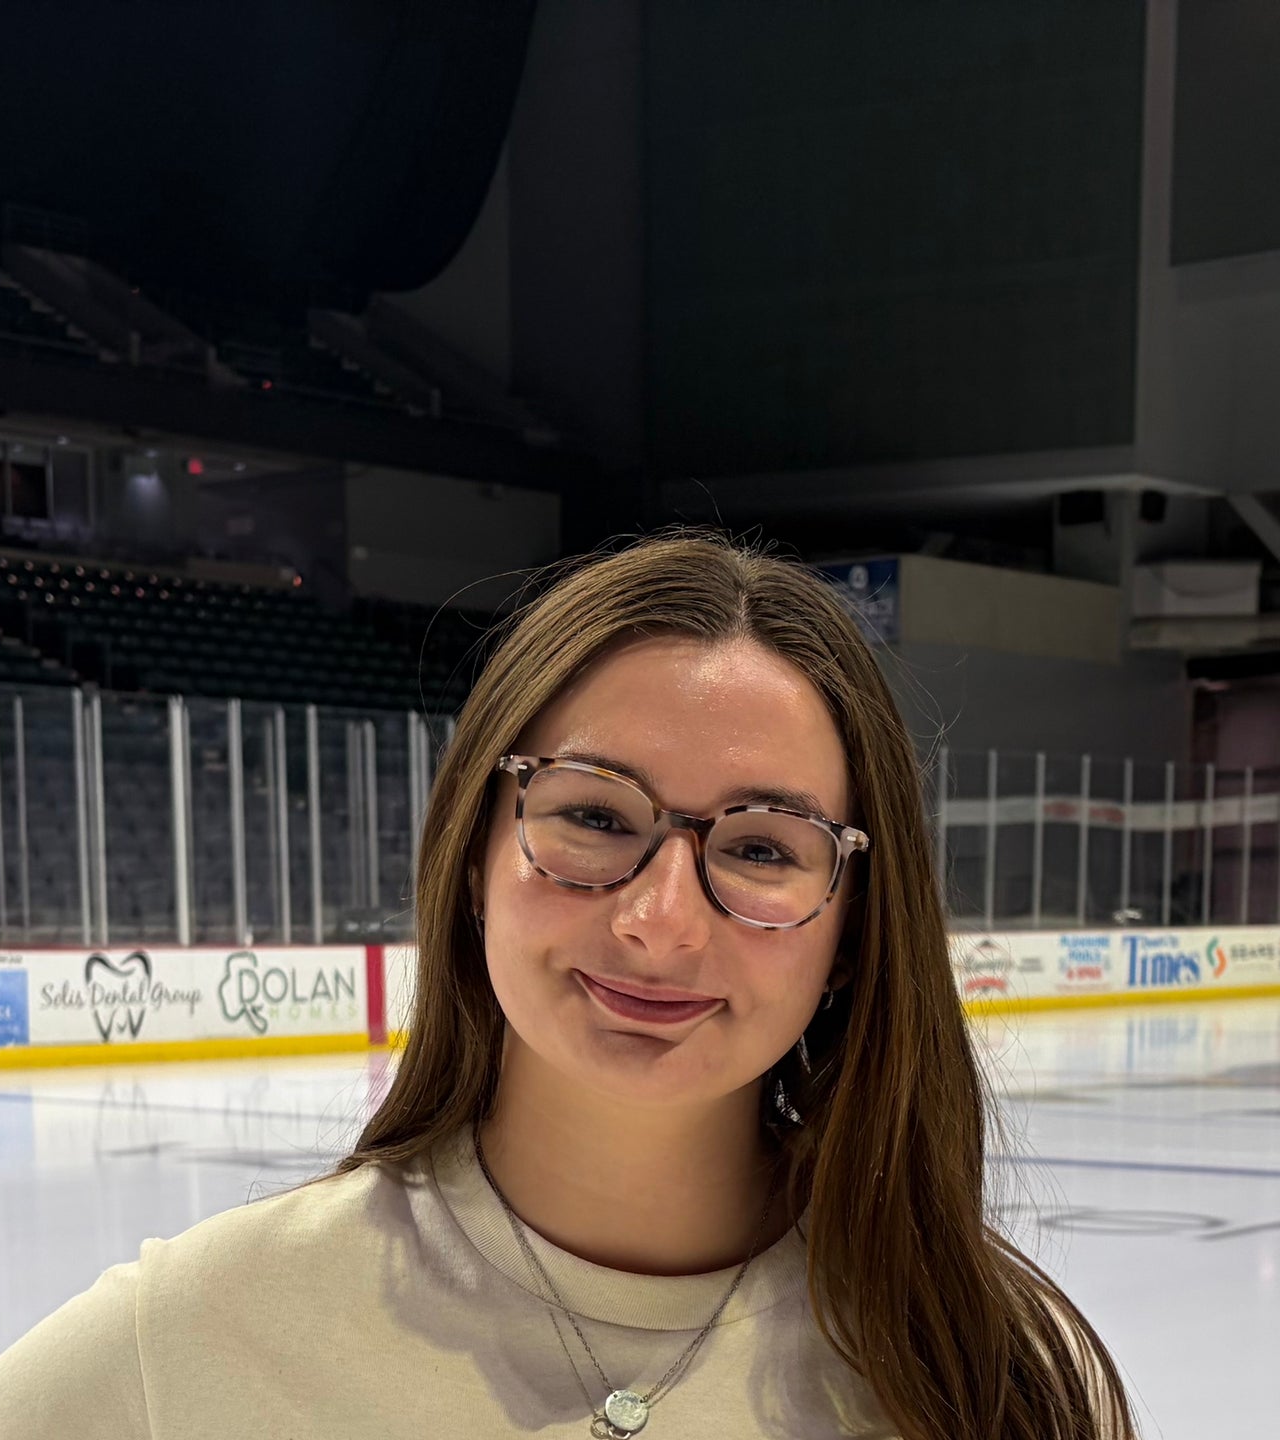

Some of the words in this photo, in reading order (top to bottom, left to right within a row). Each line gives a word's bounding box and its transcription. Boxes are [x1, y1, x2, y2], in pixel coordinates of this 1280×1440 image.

[1122, 935, 1201, 987] Times
[40, 980, 85, 1010] Solis
[89, 980, 147, 1008] Dental
[150, 981, 202, 1018] Group
[239, 967, 356, 1003] DOLAN
